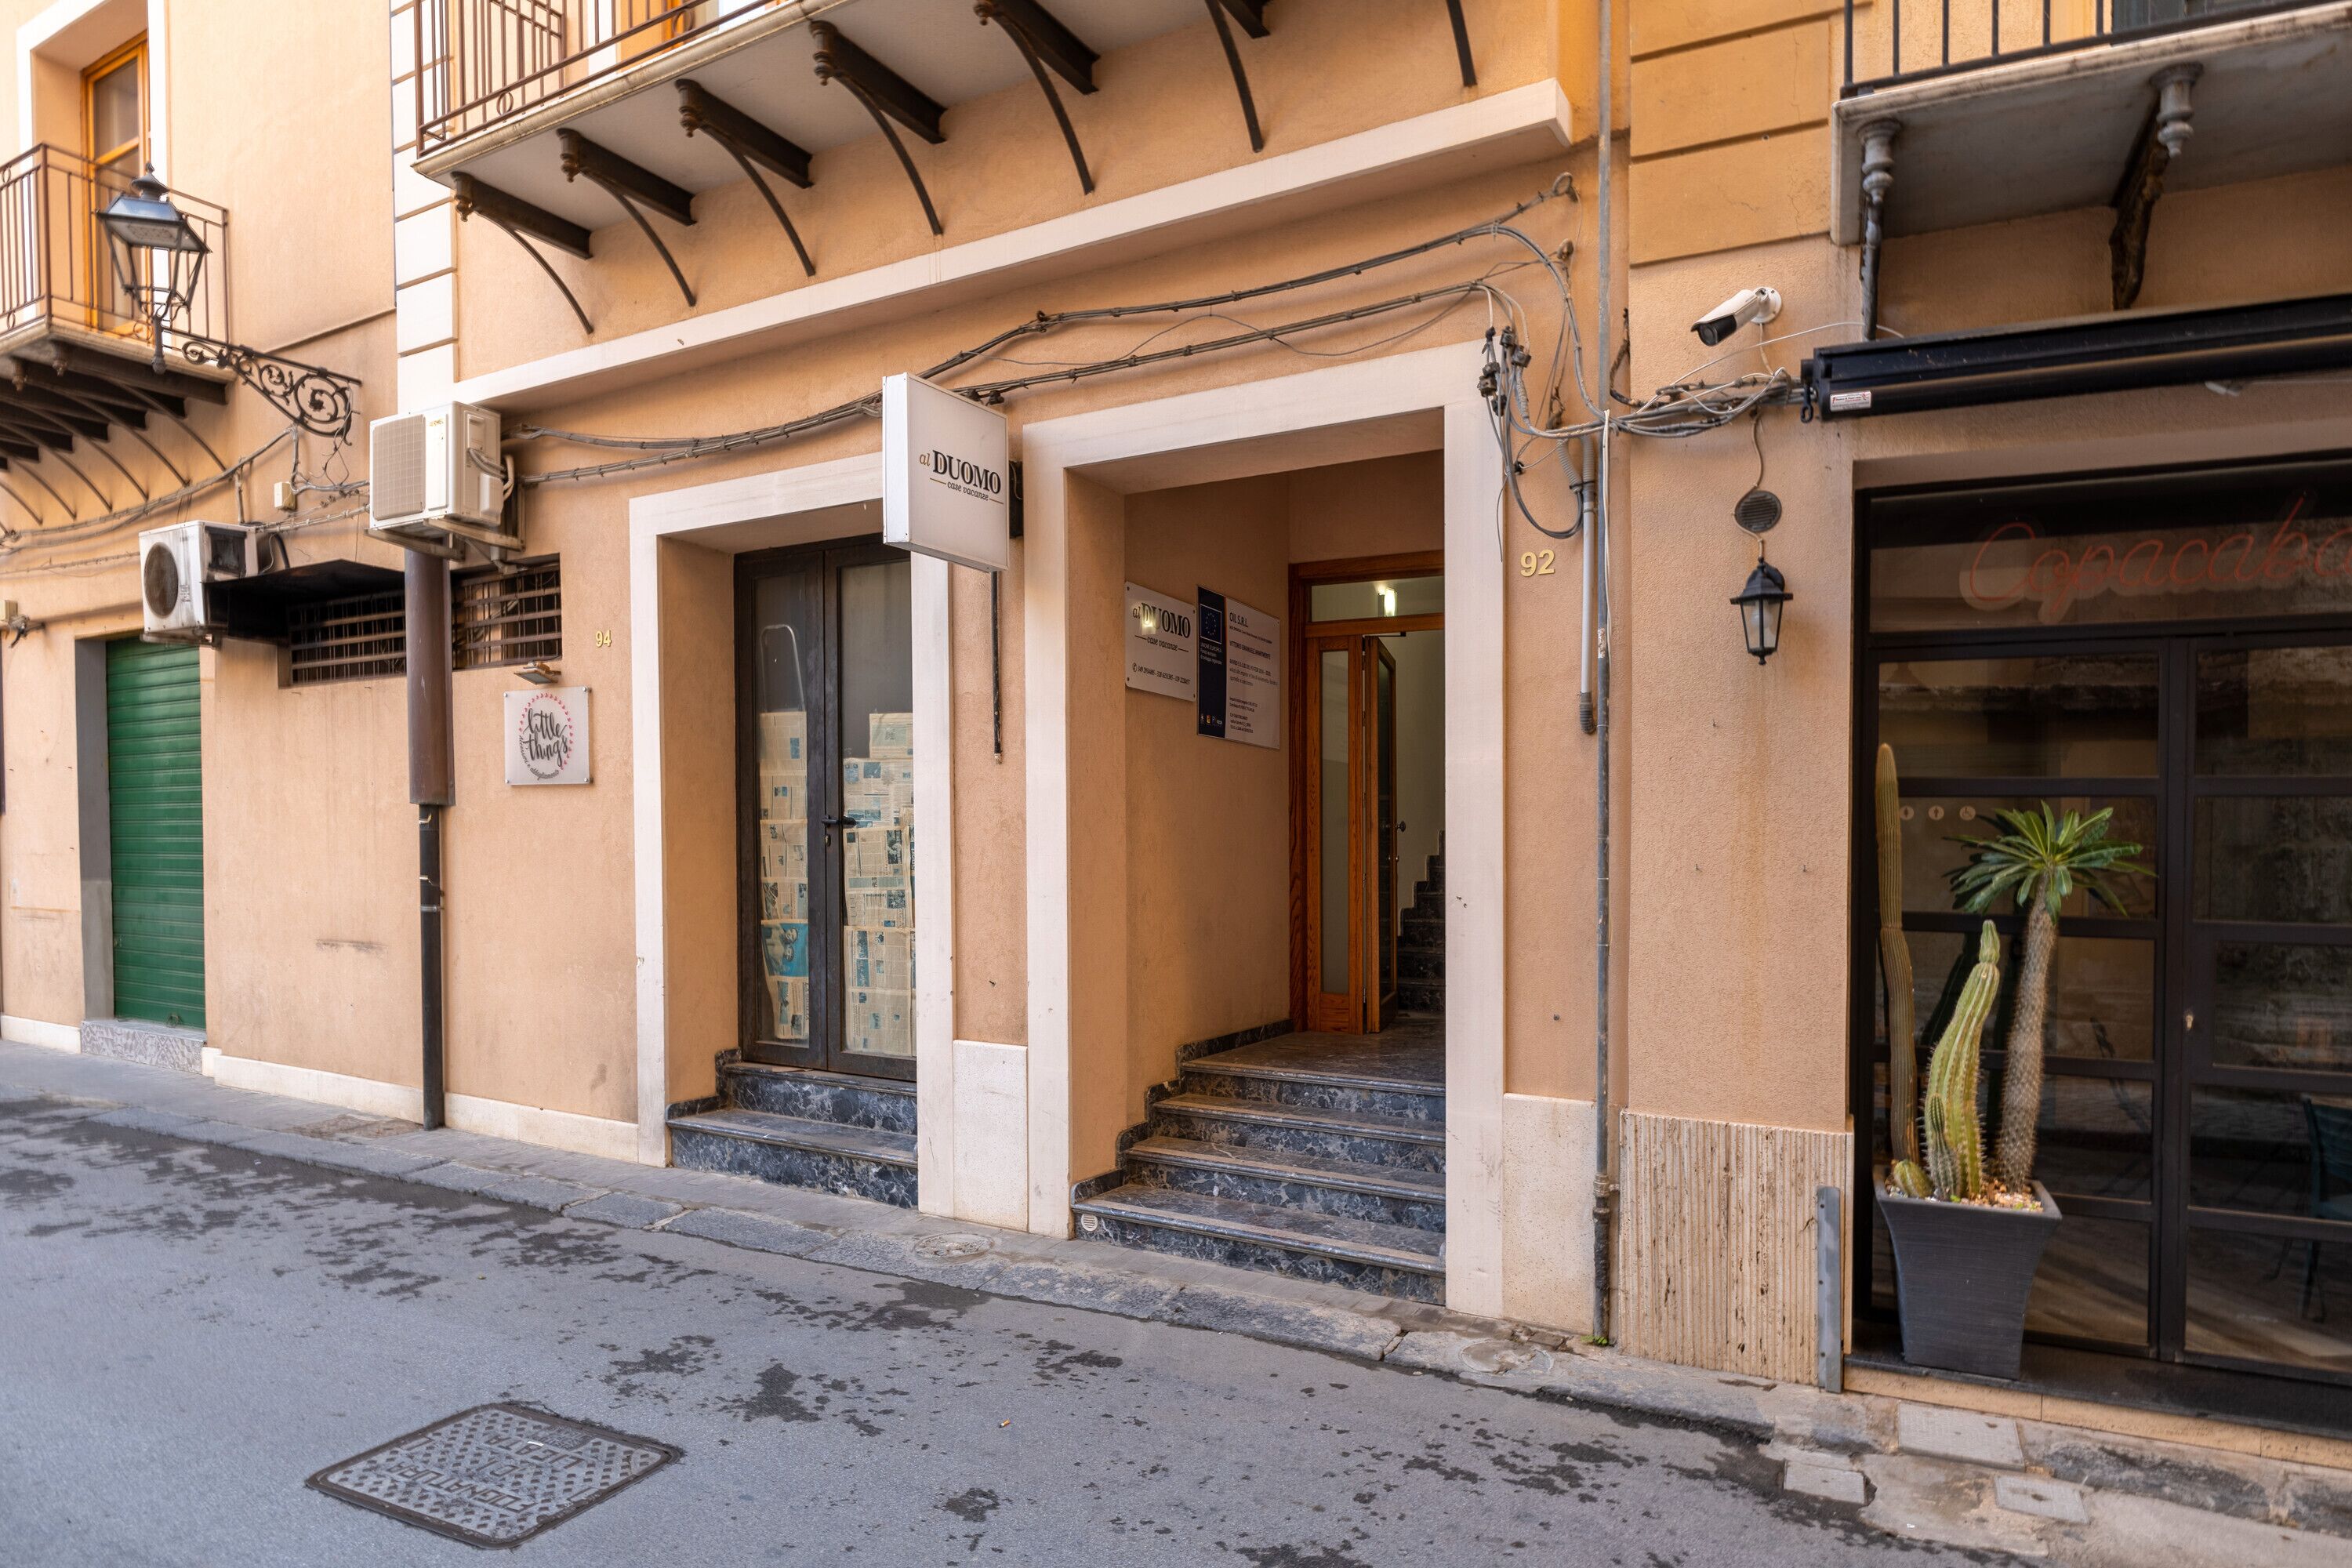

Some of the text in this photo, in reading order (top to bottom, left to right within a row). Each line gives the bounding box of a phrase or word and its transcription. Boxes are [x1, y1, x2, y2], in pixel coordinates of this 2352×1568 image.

[919, 449, 1001, 494] al DUOMO
[947, 481, 989, 501] case vacanze
[1520, 550, 1556, 577] 92
[1141, 602, 1191, 639] DUOMO
[595, 630, 613, 648] 94
[523, 707, 568, 741] little
[523, 731, 568, 768] things
[384, 1463, 537, 1513] FOGNATURA
